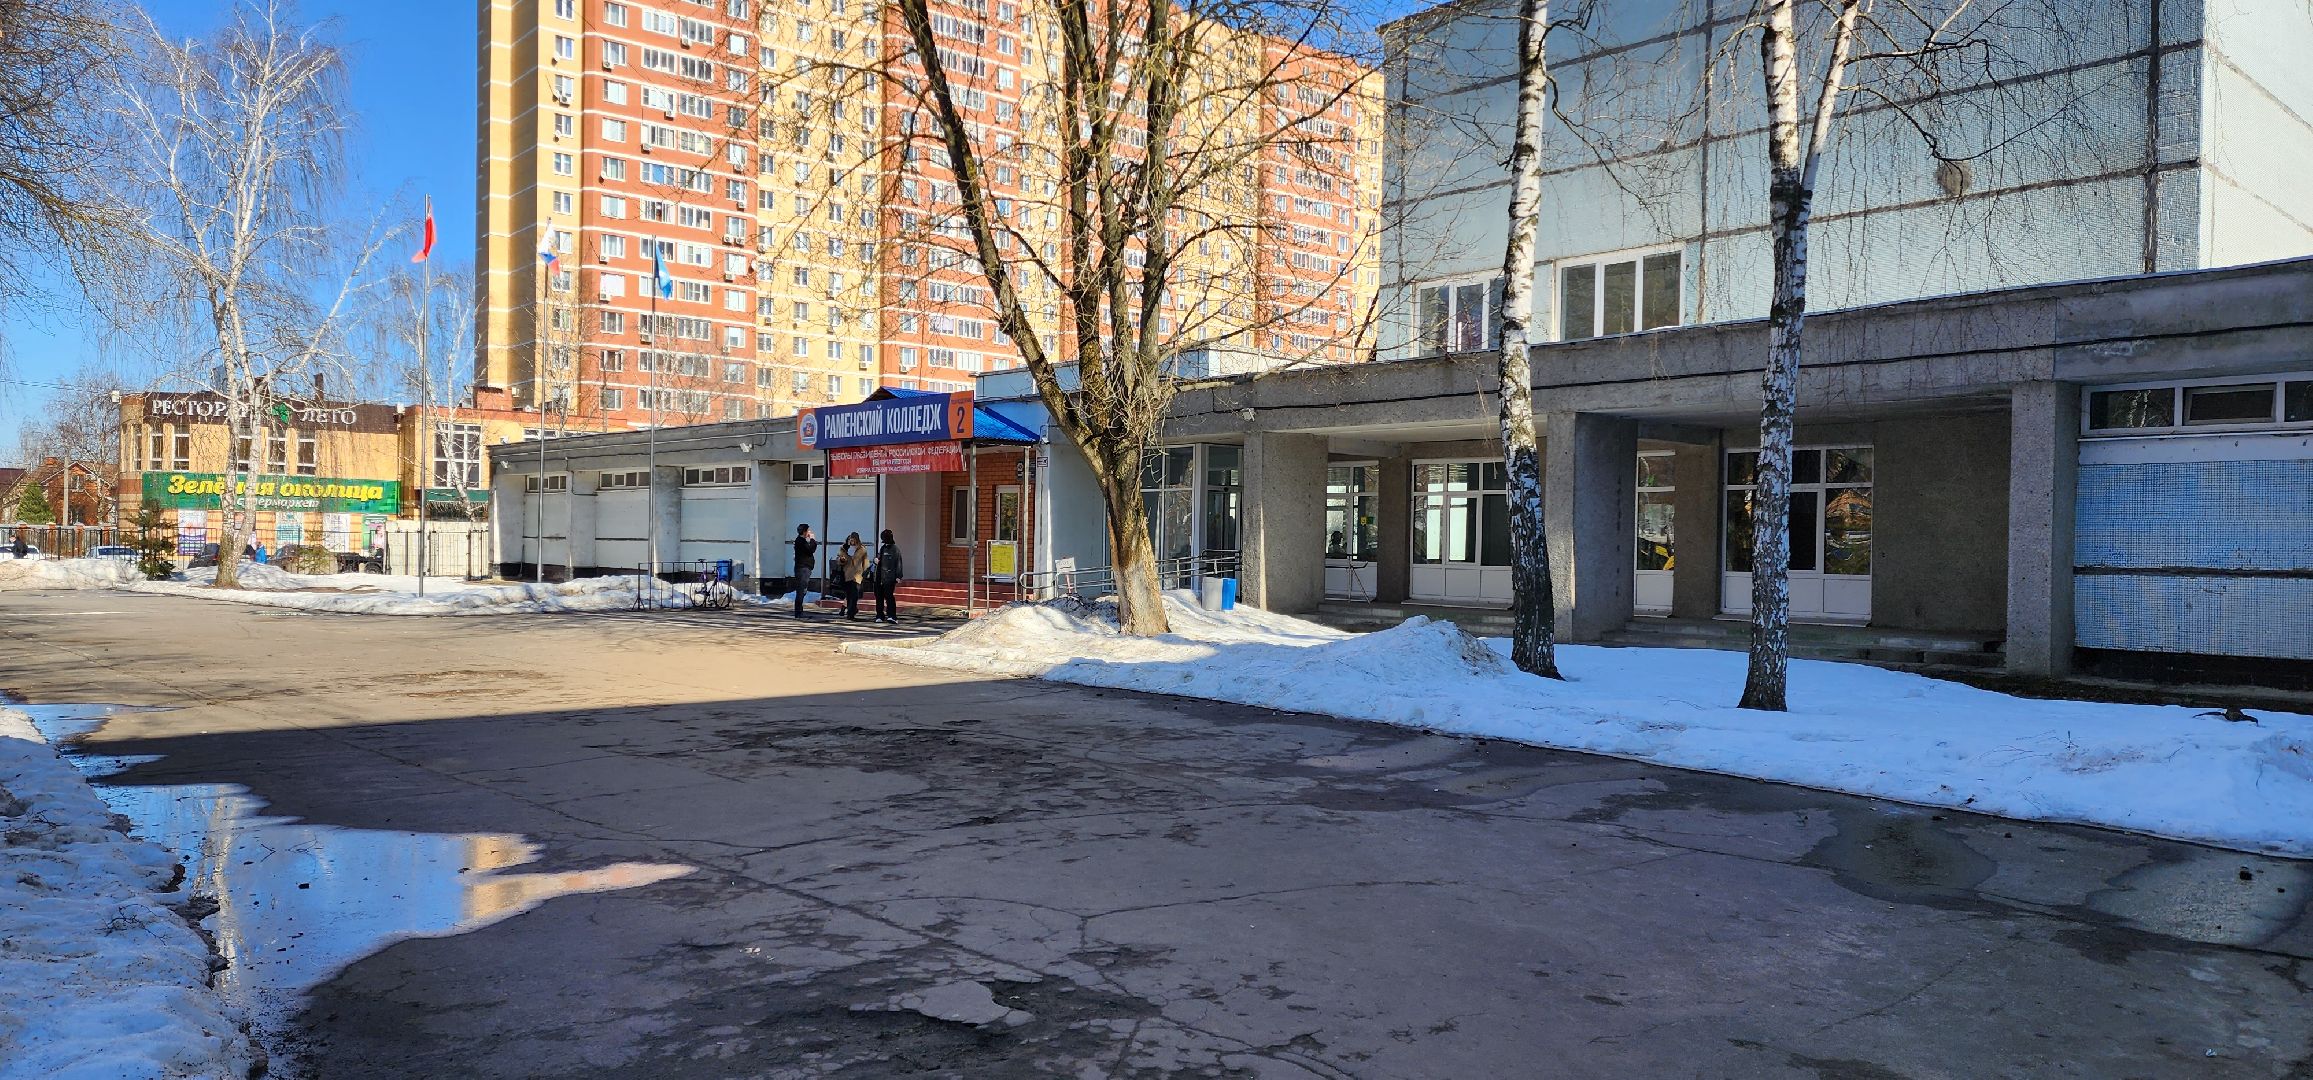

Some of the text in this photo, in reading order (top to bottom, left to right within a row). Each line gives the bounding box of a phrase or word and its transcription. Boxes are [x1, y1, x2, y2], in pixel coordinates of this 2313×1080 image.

[824, 403, 942, 439] РАМЕНСКИЙ КОЛЛЕДЖ
[956, 407, 966, 433] 2
